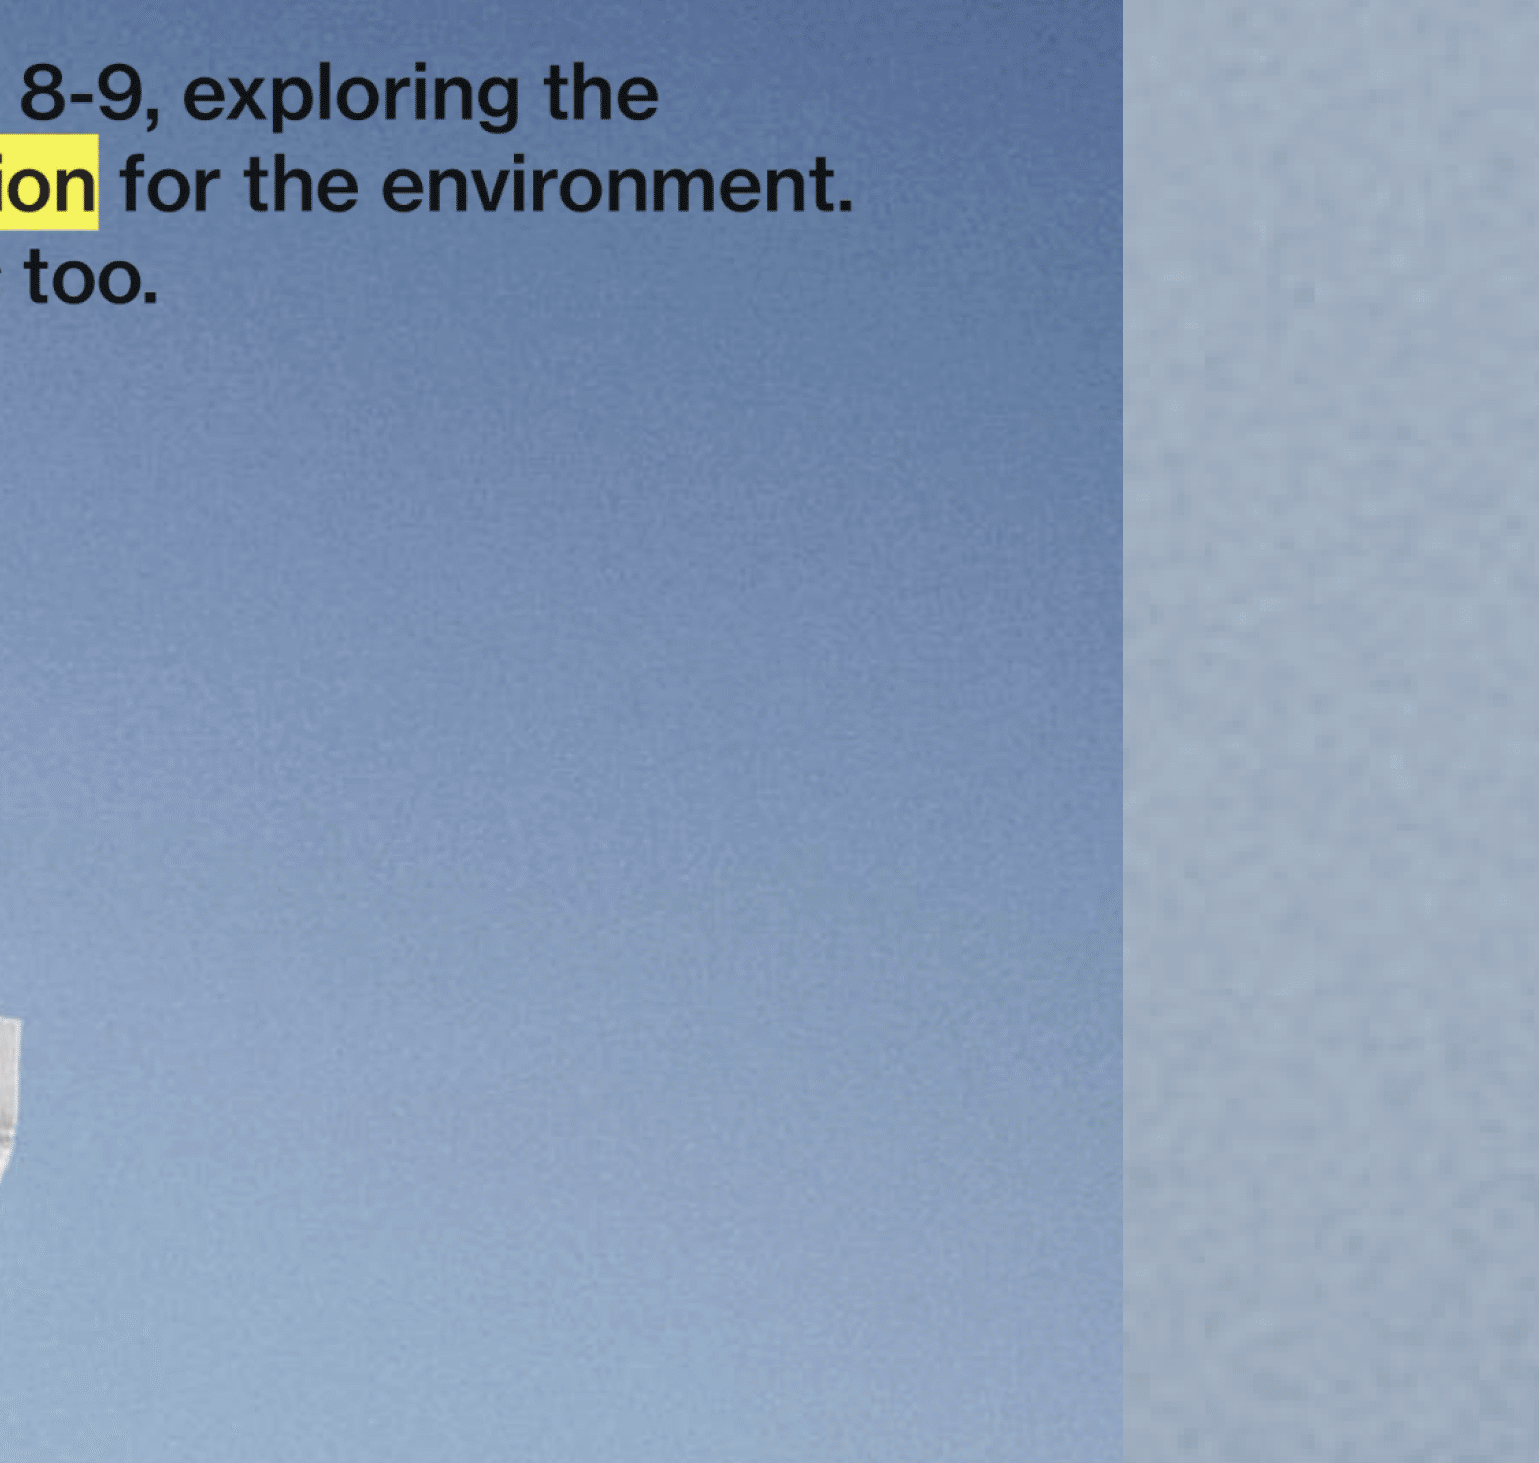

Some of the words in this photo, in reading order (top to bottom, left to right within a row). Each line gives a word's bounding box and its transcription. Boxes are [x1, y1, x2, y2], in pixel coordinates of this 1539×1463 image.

[20, 62, 159, 133] 8-9,
[183, 61, 519, 135] exploring
[543, 61, 659, 121] the
[119, 153, 221, 213] for
[243, 153, 359, 214] the
[382, 153, 852, 214] environment.
[23, 248, 157, 305] too.
